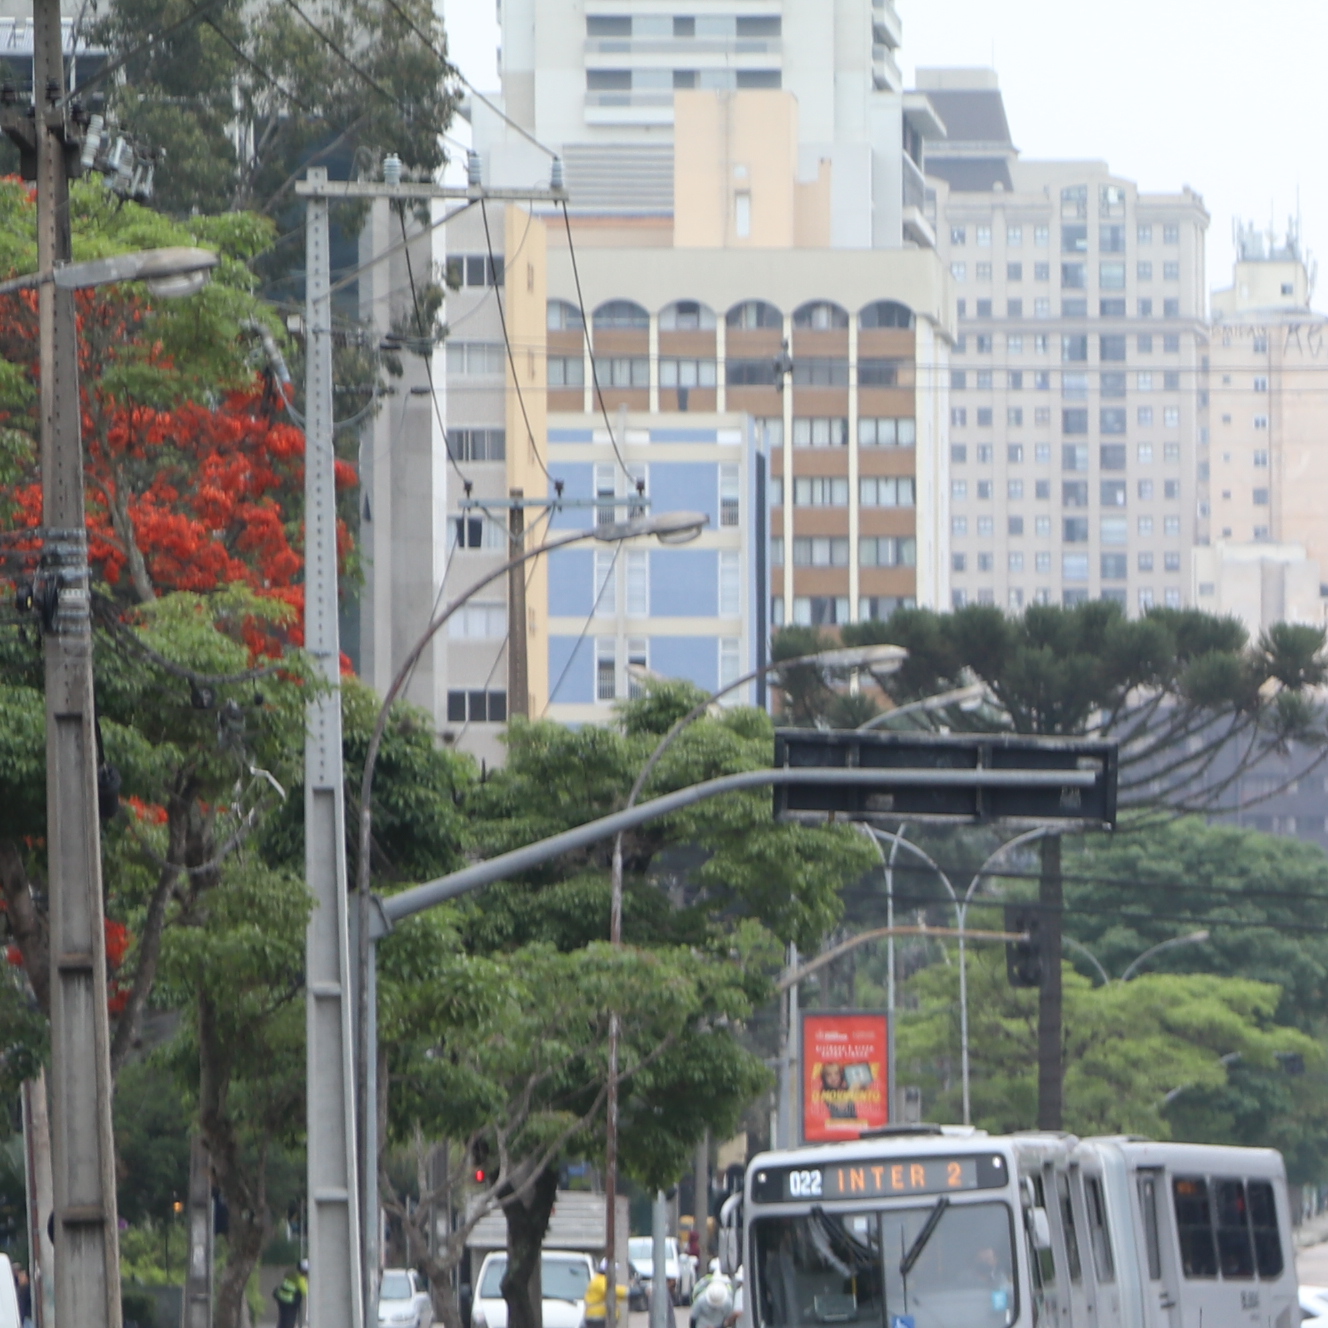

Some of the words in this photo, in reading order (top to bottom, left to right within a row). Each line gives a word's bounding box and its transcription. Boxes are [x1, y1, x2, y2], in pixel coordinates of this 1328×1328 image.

[789, 1170, 823, 1197] 022
[837, 1163, 926, 1194] INTER
[947, 1162, 962, 1187] 2
